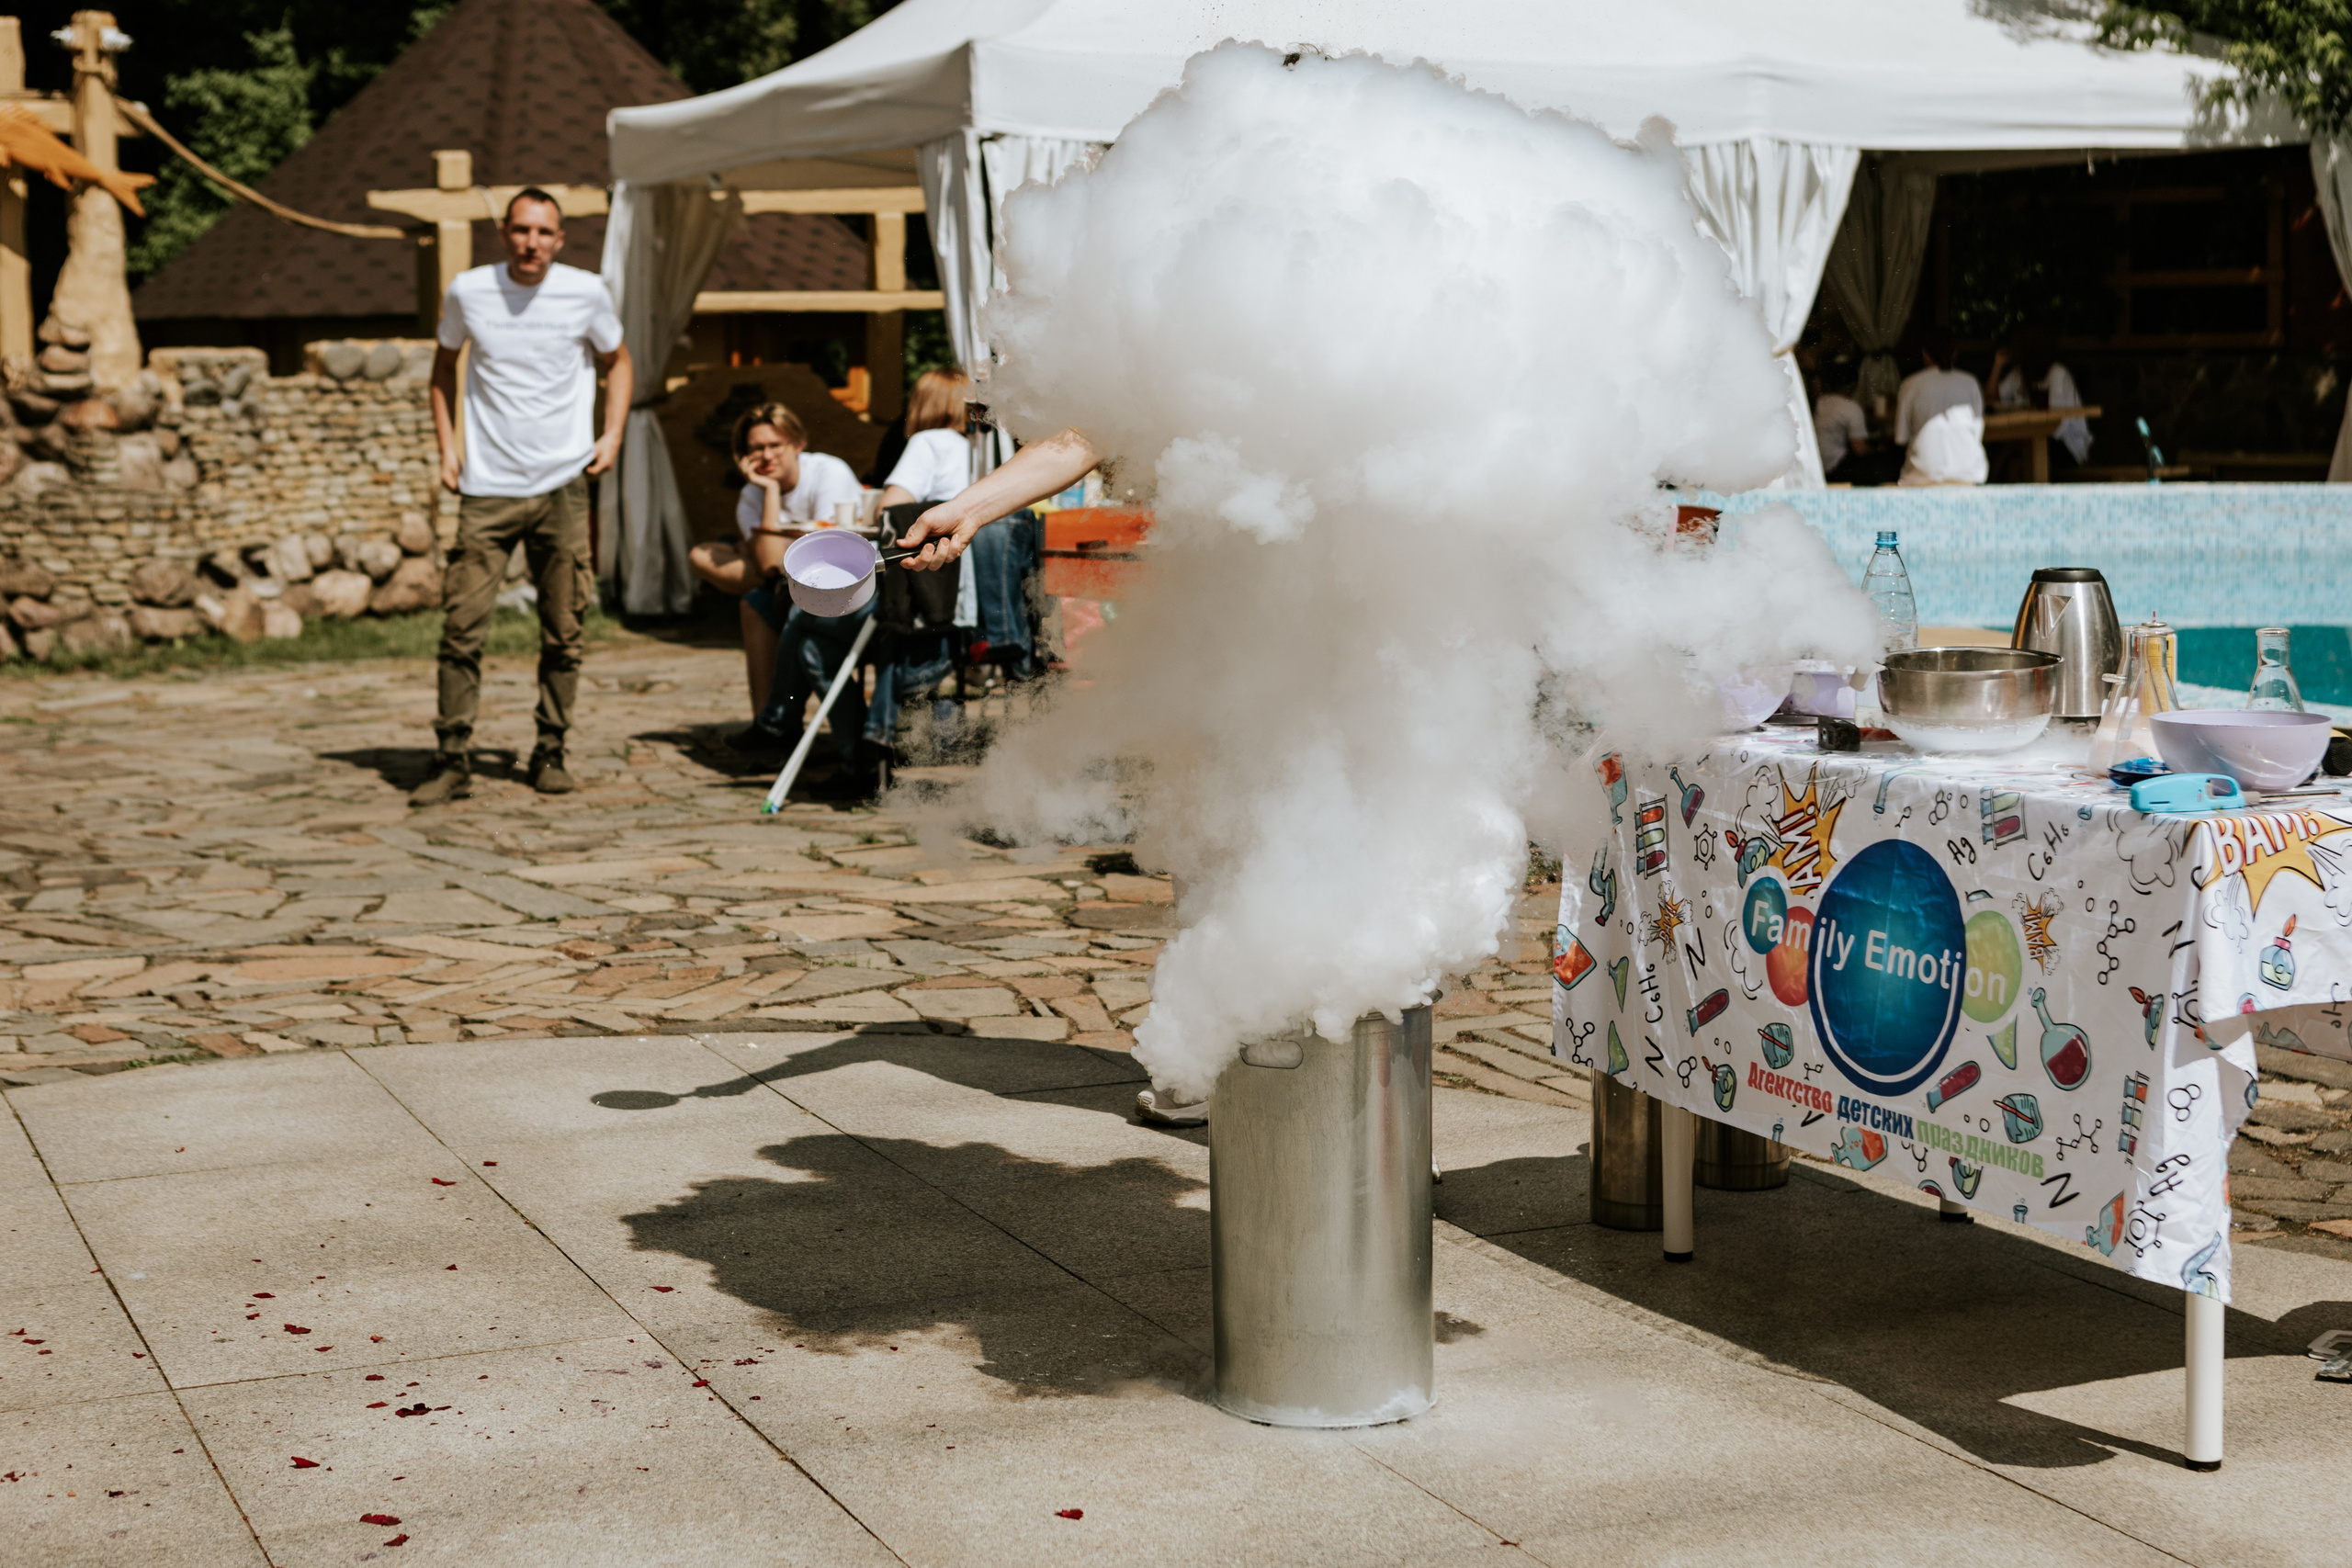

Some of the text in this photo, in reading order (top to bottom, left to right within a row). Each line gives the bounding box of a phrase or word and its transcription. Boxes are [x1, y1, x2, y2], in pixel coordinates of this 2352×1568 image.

[1779, 801, 1823, 899] AM!
[1947, 837, 1976, 865] Ag
[1750, 899, 2007, 1005] Family Emotion
[1747, 1061, 2044, 1179] Агентство детских праздников
